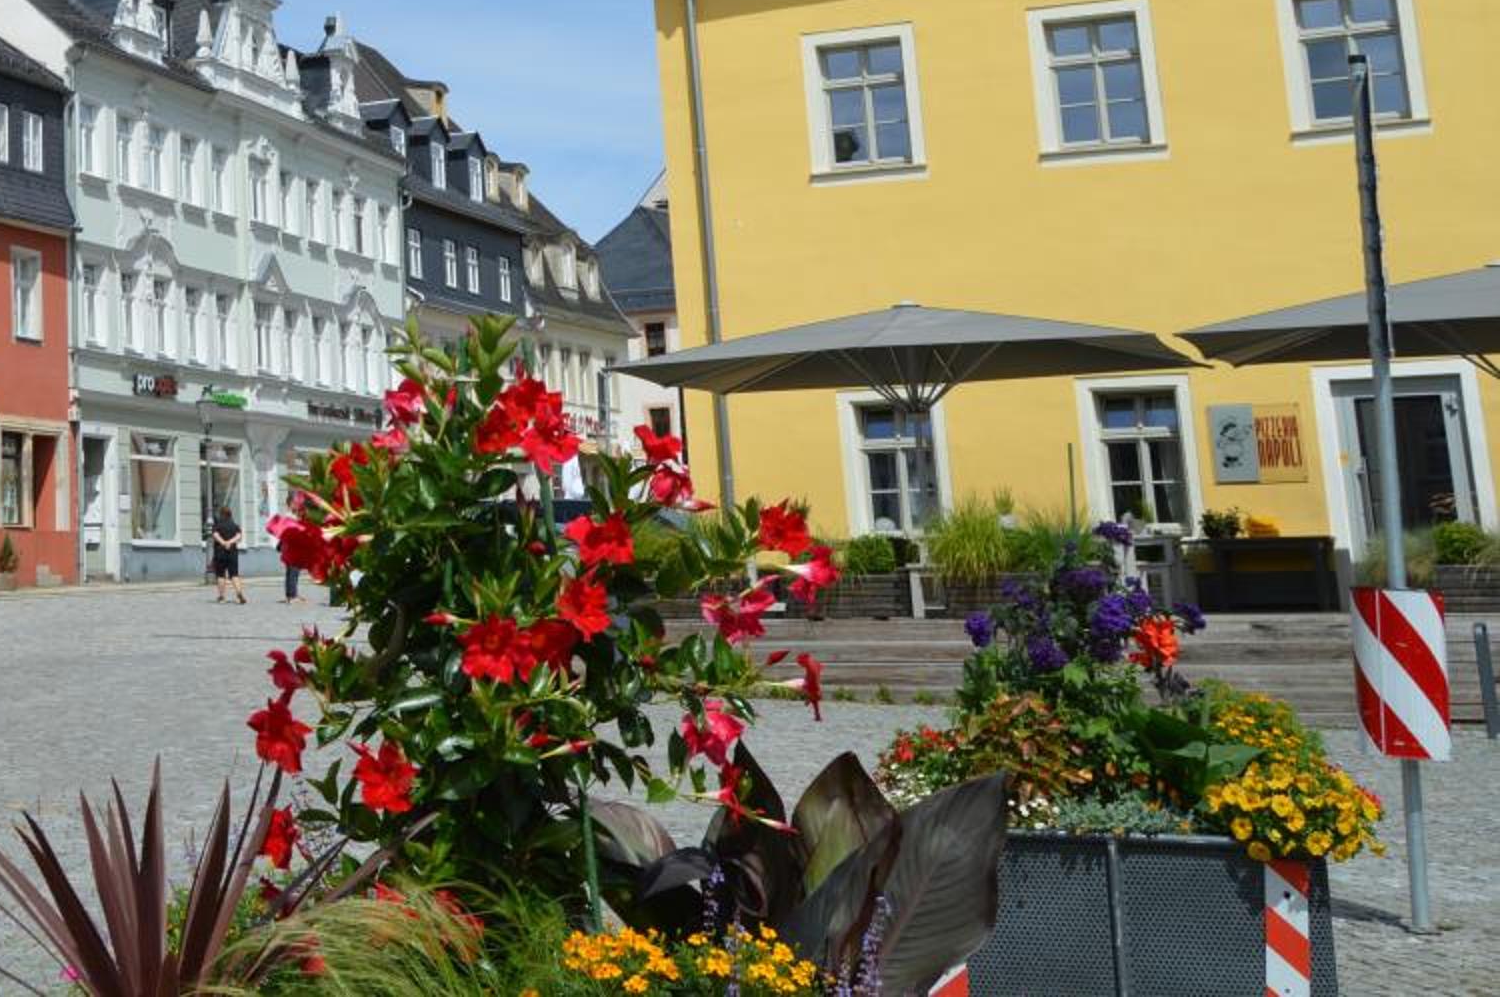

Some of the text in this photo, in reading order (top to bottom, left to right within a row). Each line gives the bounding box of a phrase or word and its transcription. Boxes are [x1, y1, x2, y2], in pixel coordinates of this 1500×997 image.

[137, 373, 155, 393] pro
[1255, 416, 1299, 439] PIZZERIA
[1257, 438, 1302, 468] NAPOLI
